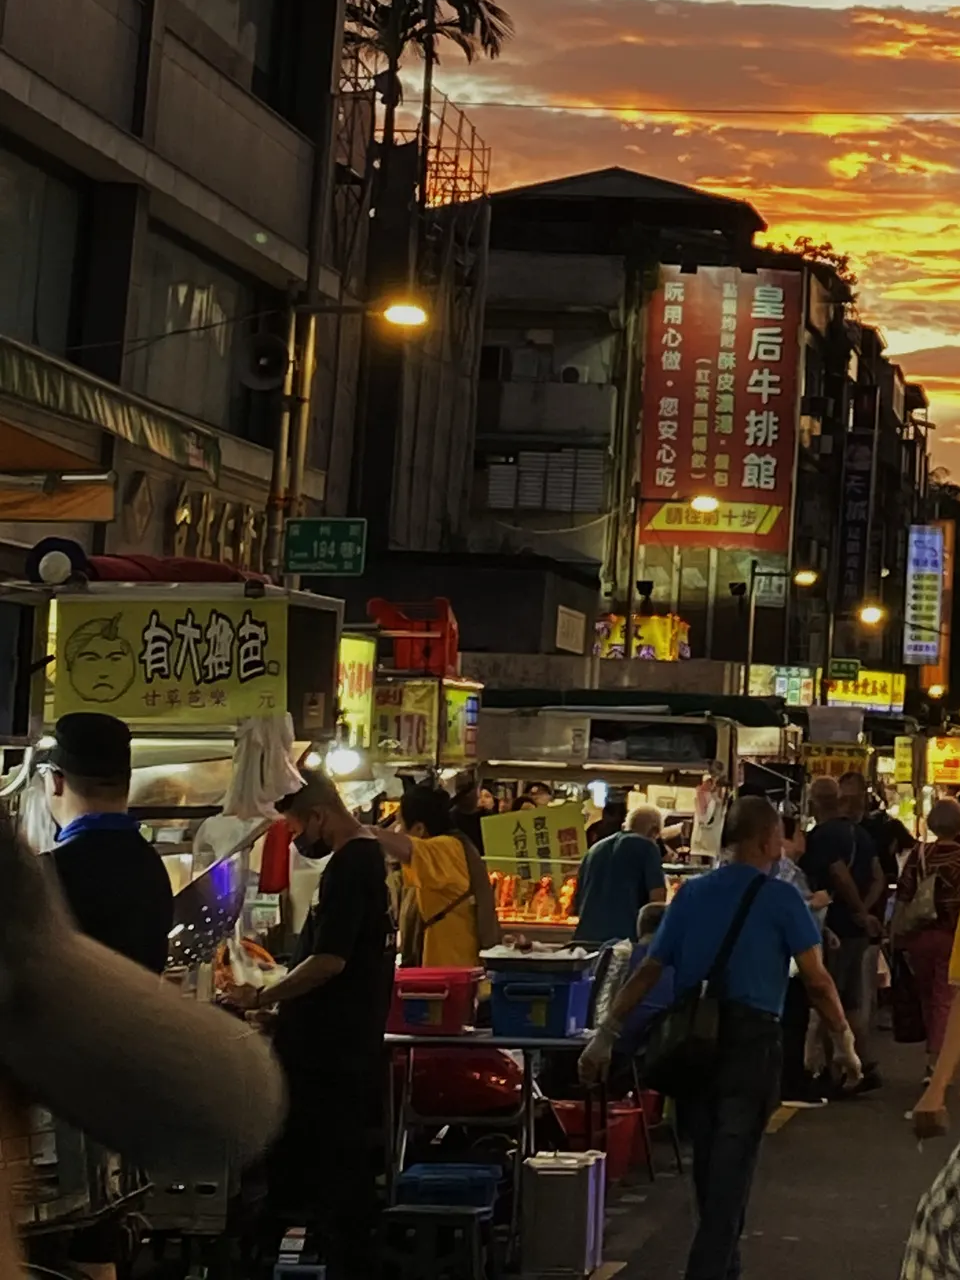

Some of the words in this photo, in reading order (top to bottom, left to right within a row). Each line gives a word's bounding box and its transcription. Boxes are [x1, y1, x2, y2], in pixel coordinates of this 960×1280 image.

[741, 284, 785, 490] 皇后牛排館
[142, 689, 227, 708] 甘草芭樂
[258, 690, 276, 709] 元
